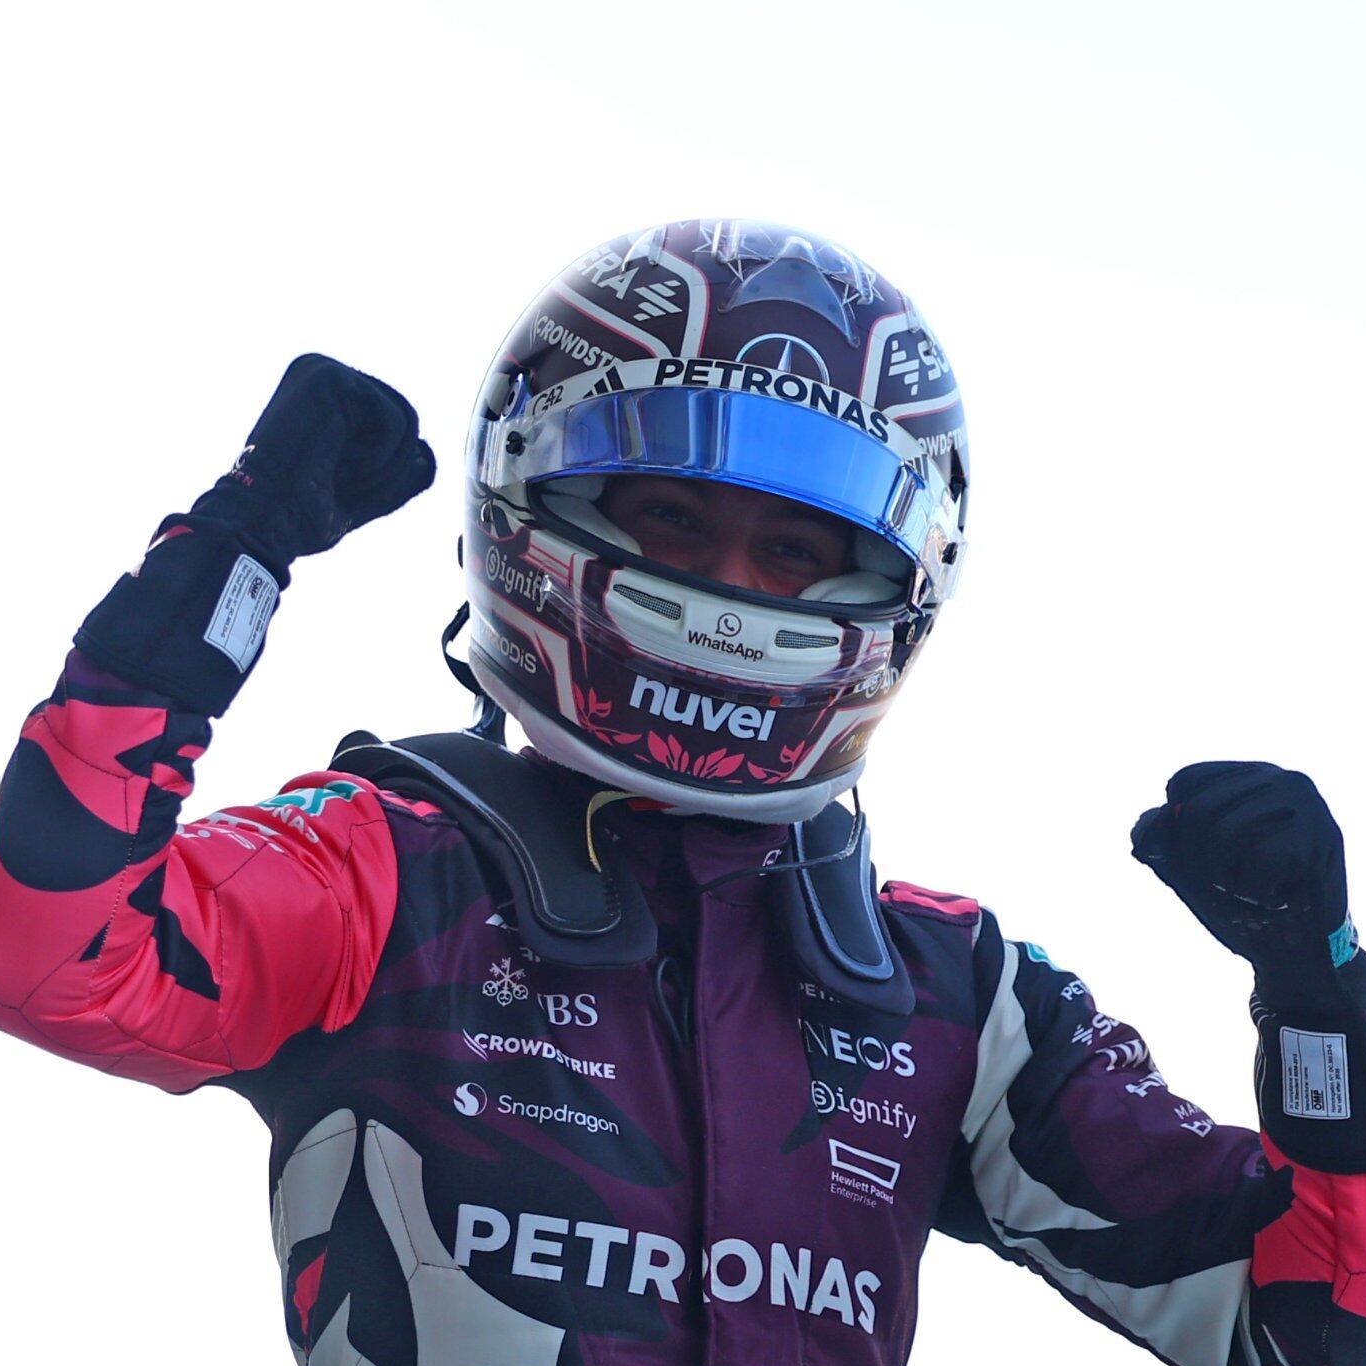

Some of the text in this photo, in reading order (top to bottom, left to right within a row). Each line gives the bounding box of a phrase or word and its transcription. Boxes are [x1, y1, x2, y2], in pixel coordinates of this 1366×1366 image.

[654, 358, 889, 444] PETRONAS
[688, 630, 764, 662] WhatsApp
[629, 675, 781, 742] nuvei
[473, 1032, 616, 1080] CROWDSTRIKE
[497, 1094, 620, 1136] Snapdragon
[1313, 1090, 1322, 1110] OMP
[830, 1183, 877, 1208] Enterprise
[831, 1171, 869, 1192] Hewlett
[454, 1203, 882, 1335] PETRONAS
